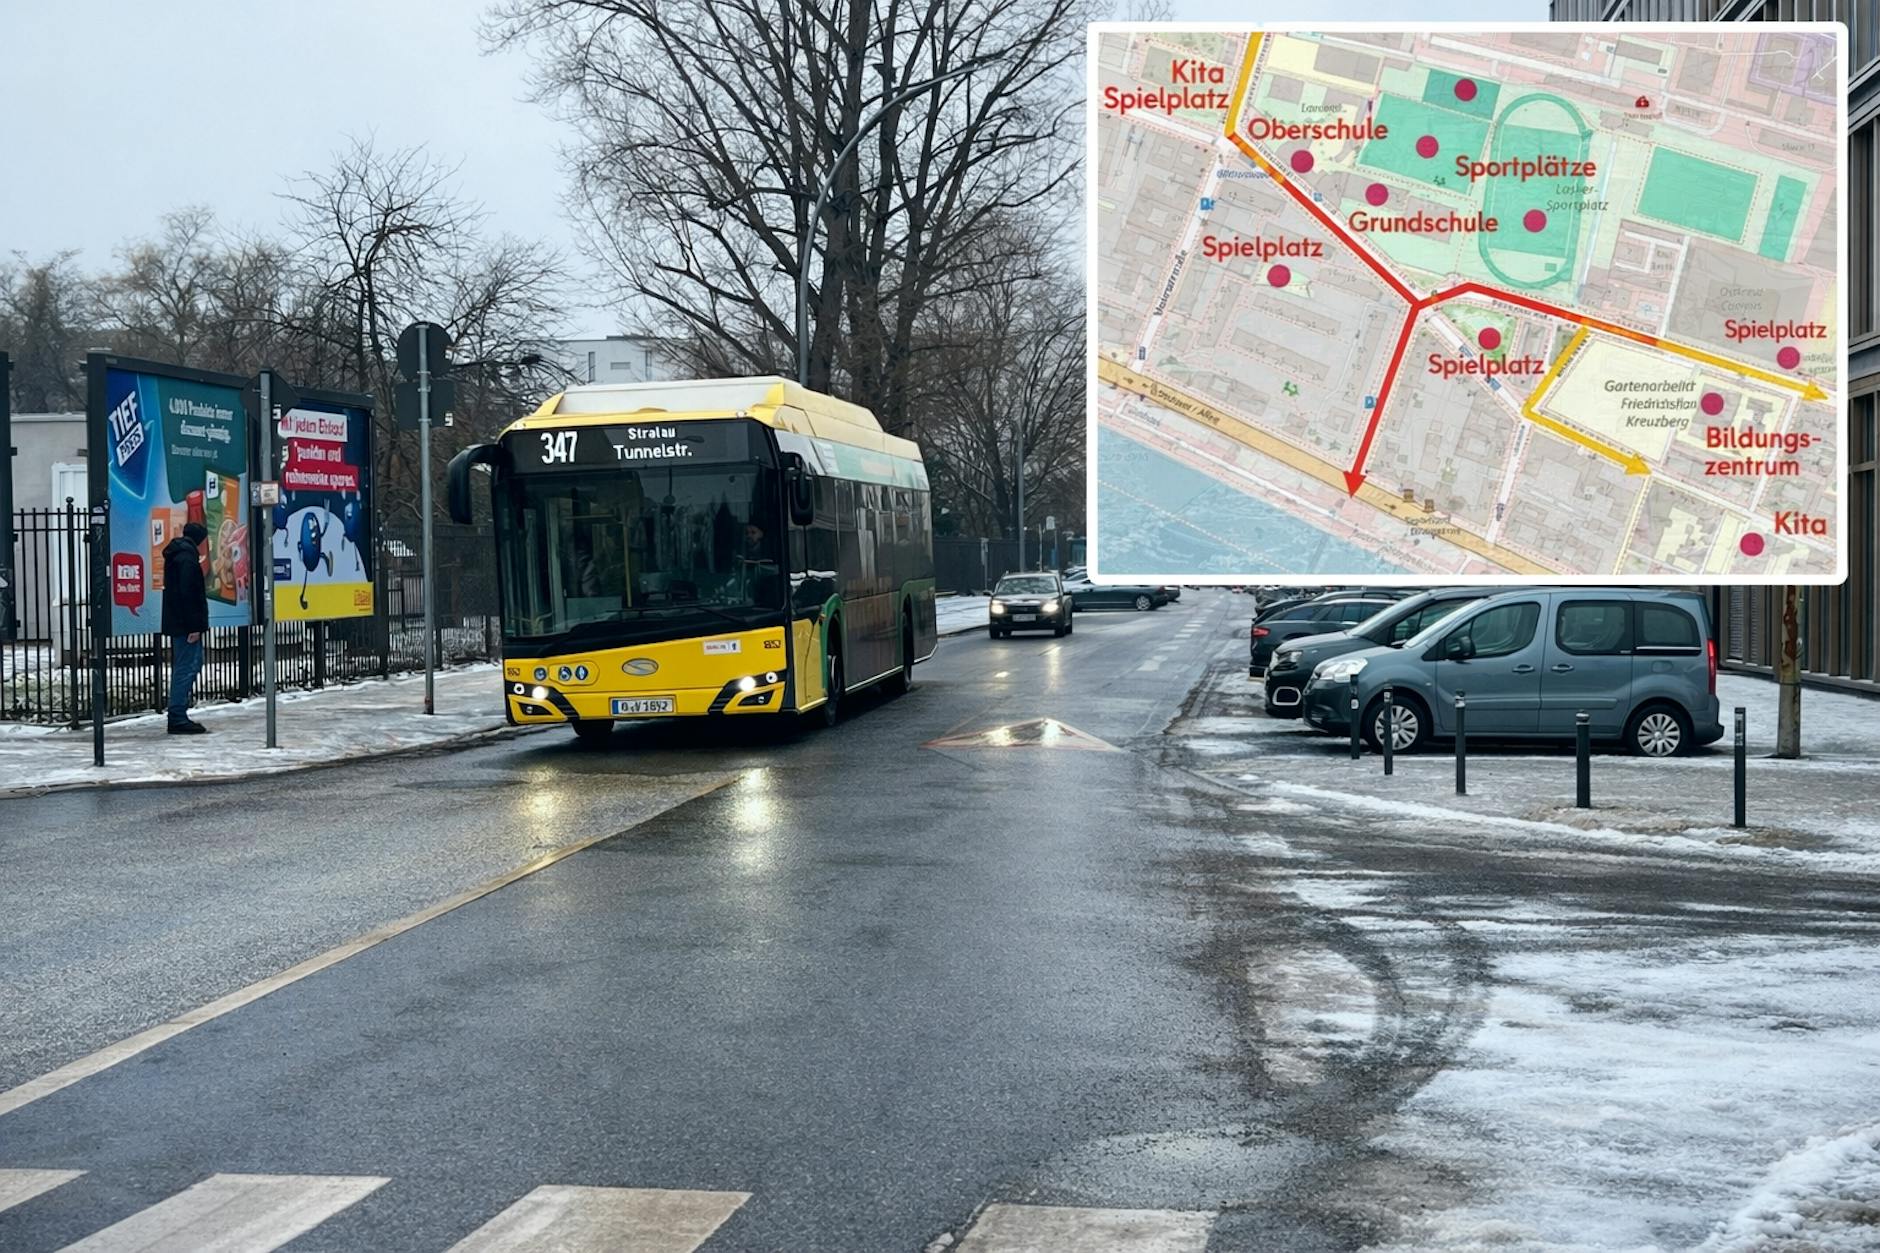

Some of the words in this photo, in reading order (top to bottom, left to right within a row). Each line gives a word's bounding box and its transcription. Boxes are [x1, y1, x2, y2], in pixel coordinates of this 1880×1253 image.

[627, 426, 676, 440] Stralau
[540, 430, 578, 464] 347
[613, 442, 693, 460] Tunnelstr.
